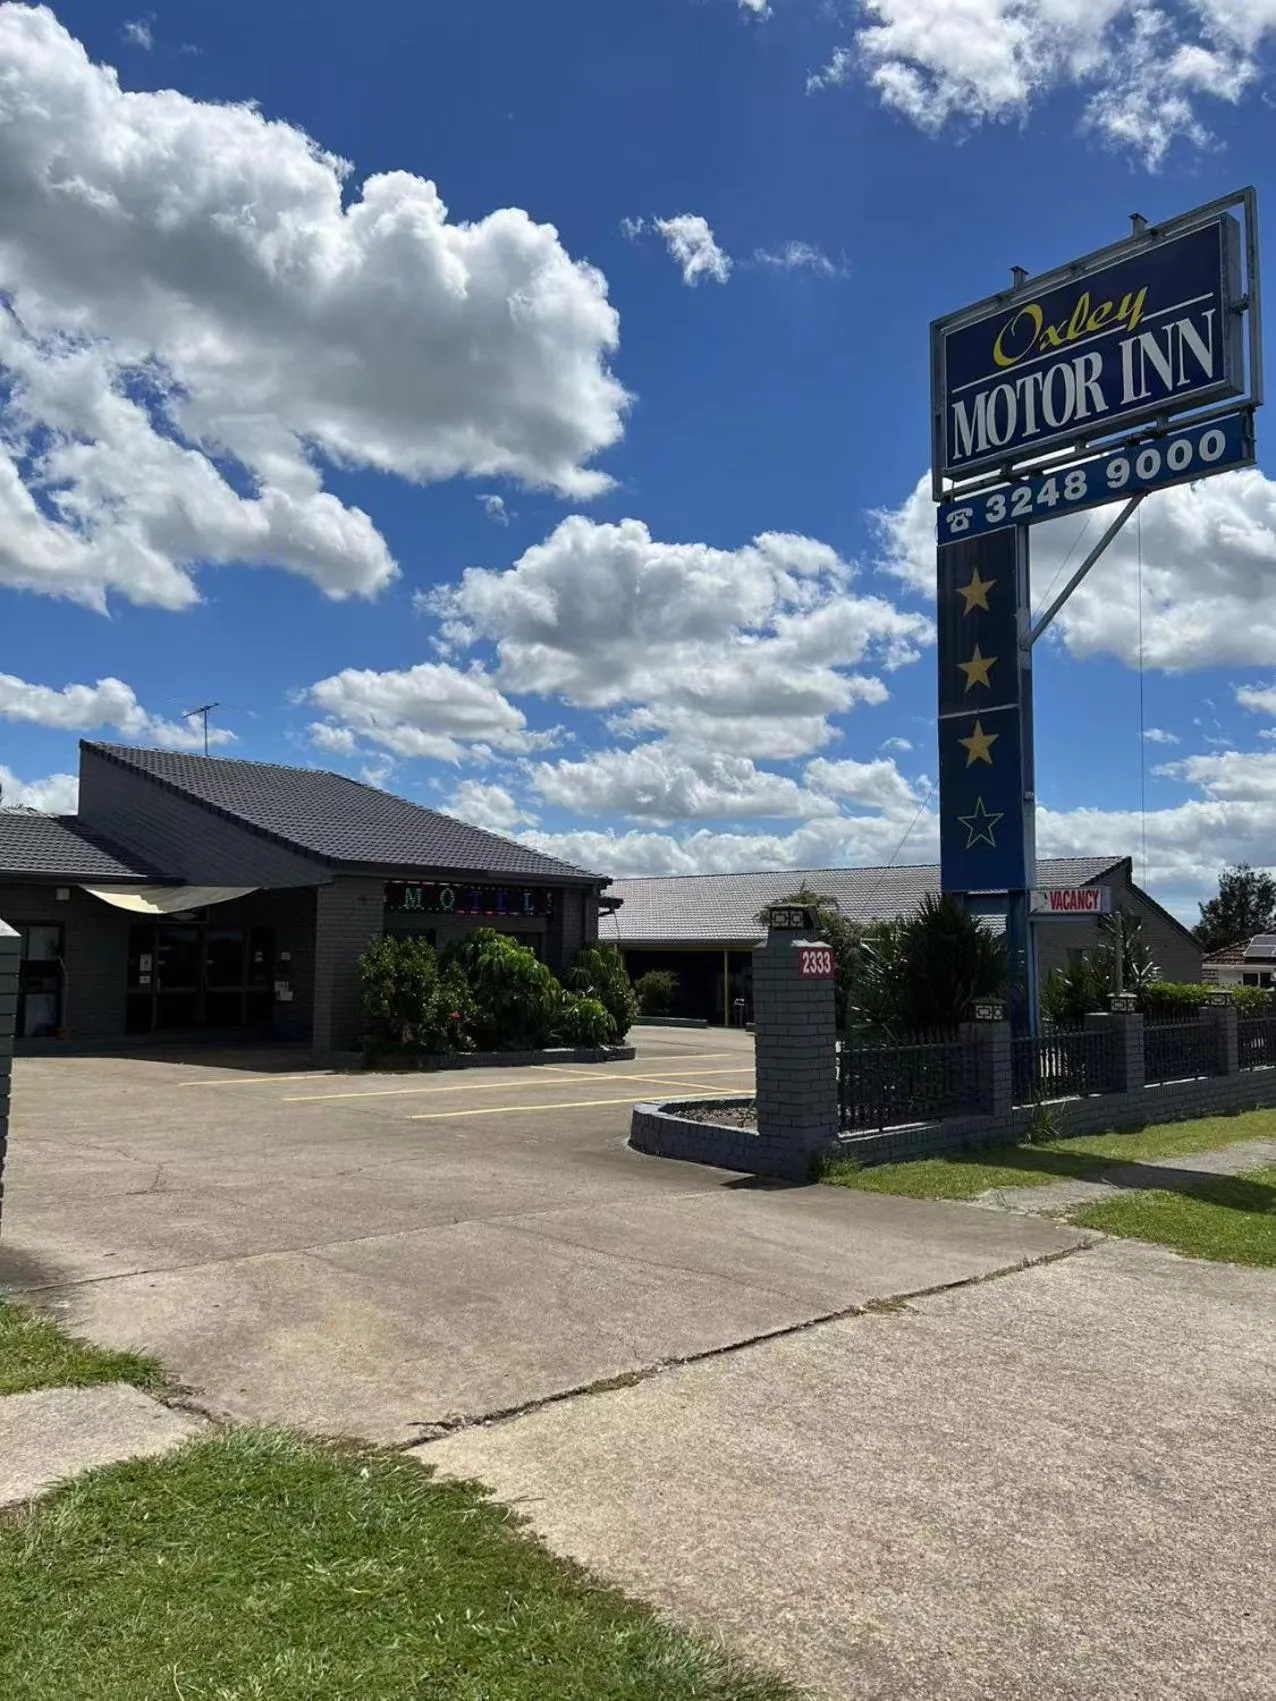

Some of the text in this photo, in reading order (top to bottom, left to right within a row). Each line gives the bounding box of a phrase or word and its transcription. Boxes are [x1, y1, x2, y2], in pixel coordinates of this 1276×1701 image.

[993, 286, 1148, 366] Oxley
[951, 309, 1216, 460] MOTOR INN
[985, 429, 1226, 524] 3248 9000
[1049, 890, 1099, 910] VACANCY
[802, 951, 831, 973] 2333
